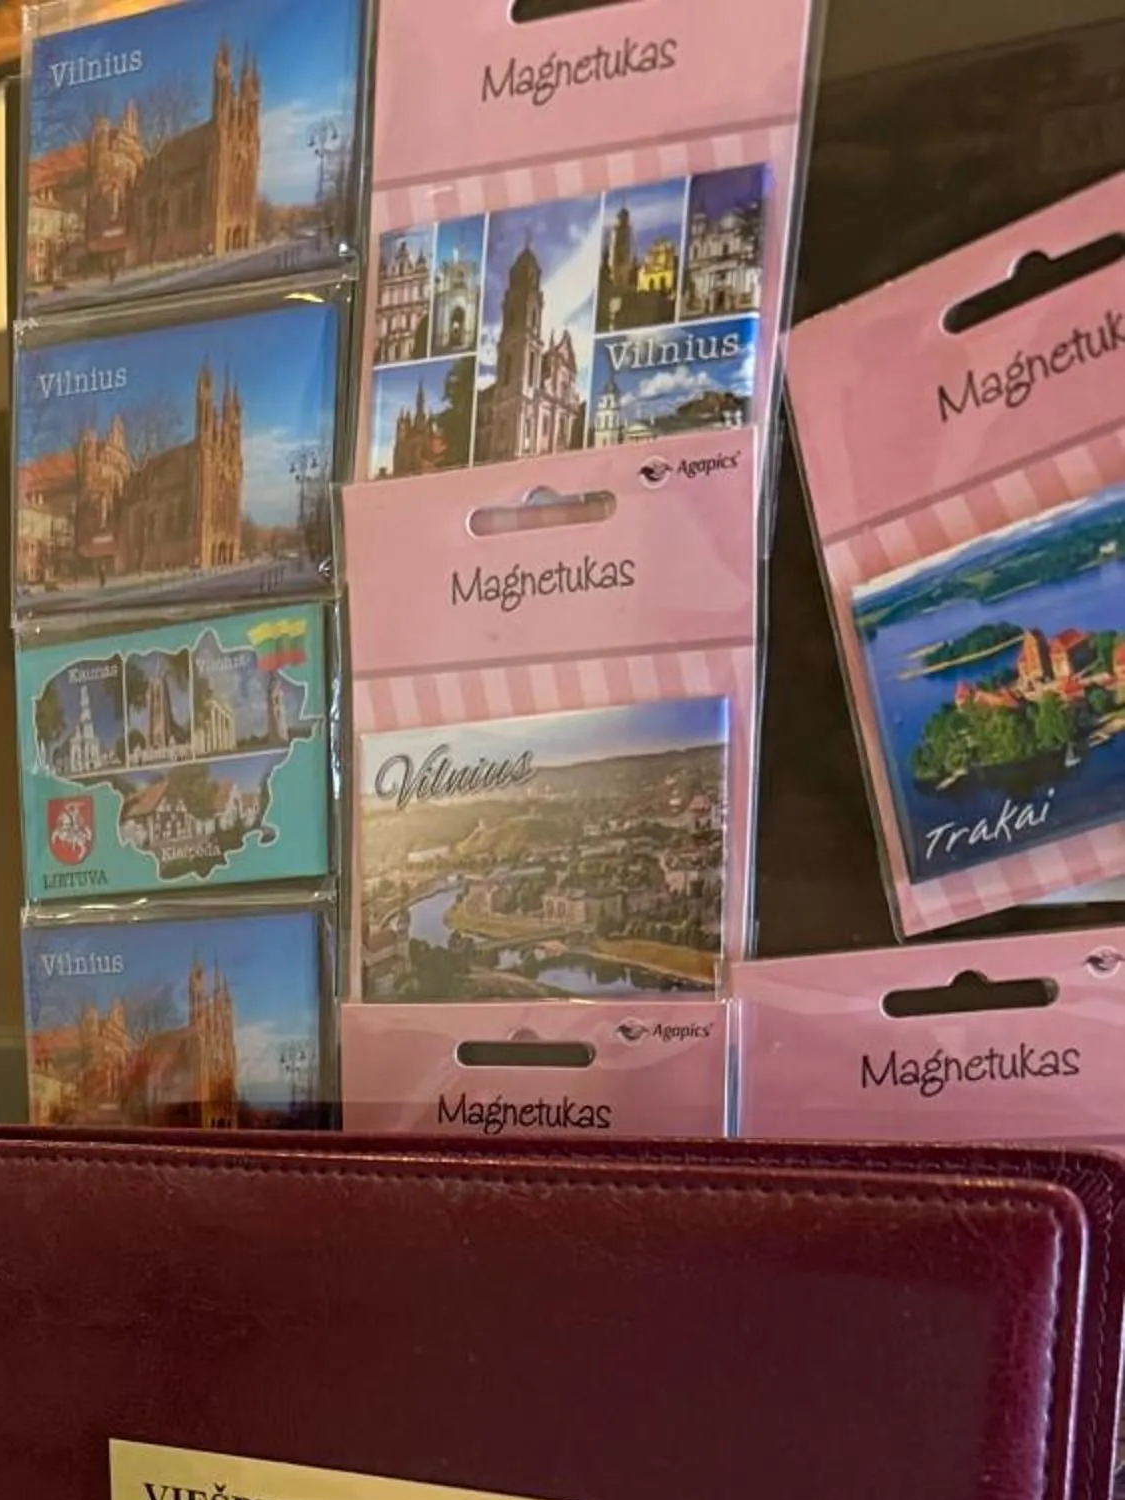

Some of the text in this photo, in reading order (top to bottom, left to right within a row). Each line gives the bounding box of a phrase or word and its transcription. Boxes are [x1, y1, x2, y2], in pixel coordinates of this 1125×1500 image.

[49, 49, 144, 89] Vilnius
[481, 37, 679, 106] Magnetukas
[605, 331, 740, 374] Vilnius
[37, 366, 128, 400] Vilnius
[450, 555, 636, 613] Magnetukas
[375, 743, 539, 810] Vilnius
[925, 788, 1056, 861] Trakai
[43, 869, 109, 890] LIETUVA
[40, 952, 125, 977] Vilnius
[860, 1042, 1081, 1098] Magnetukas
[437, 1093, 612, 1136] Magnetukas
